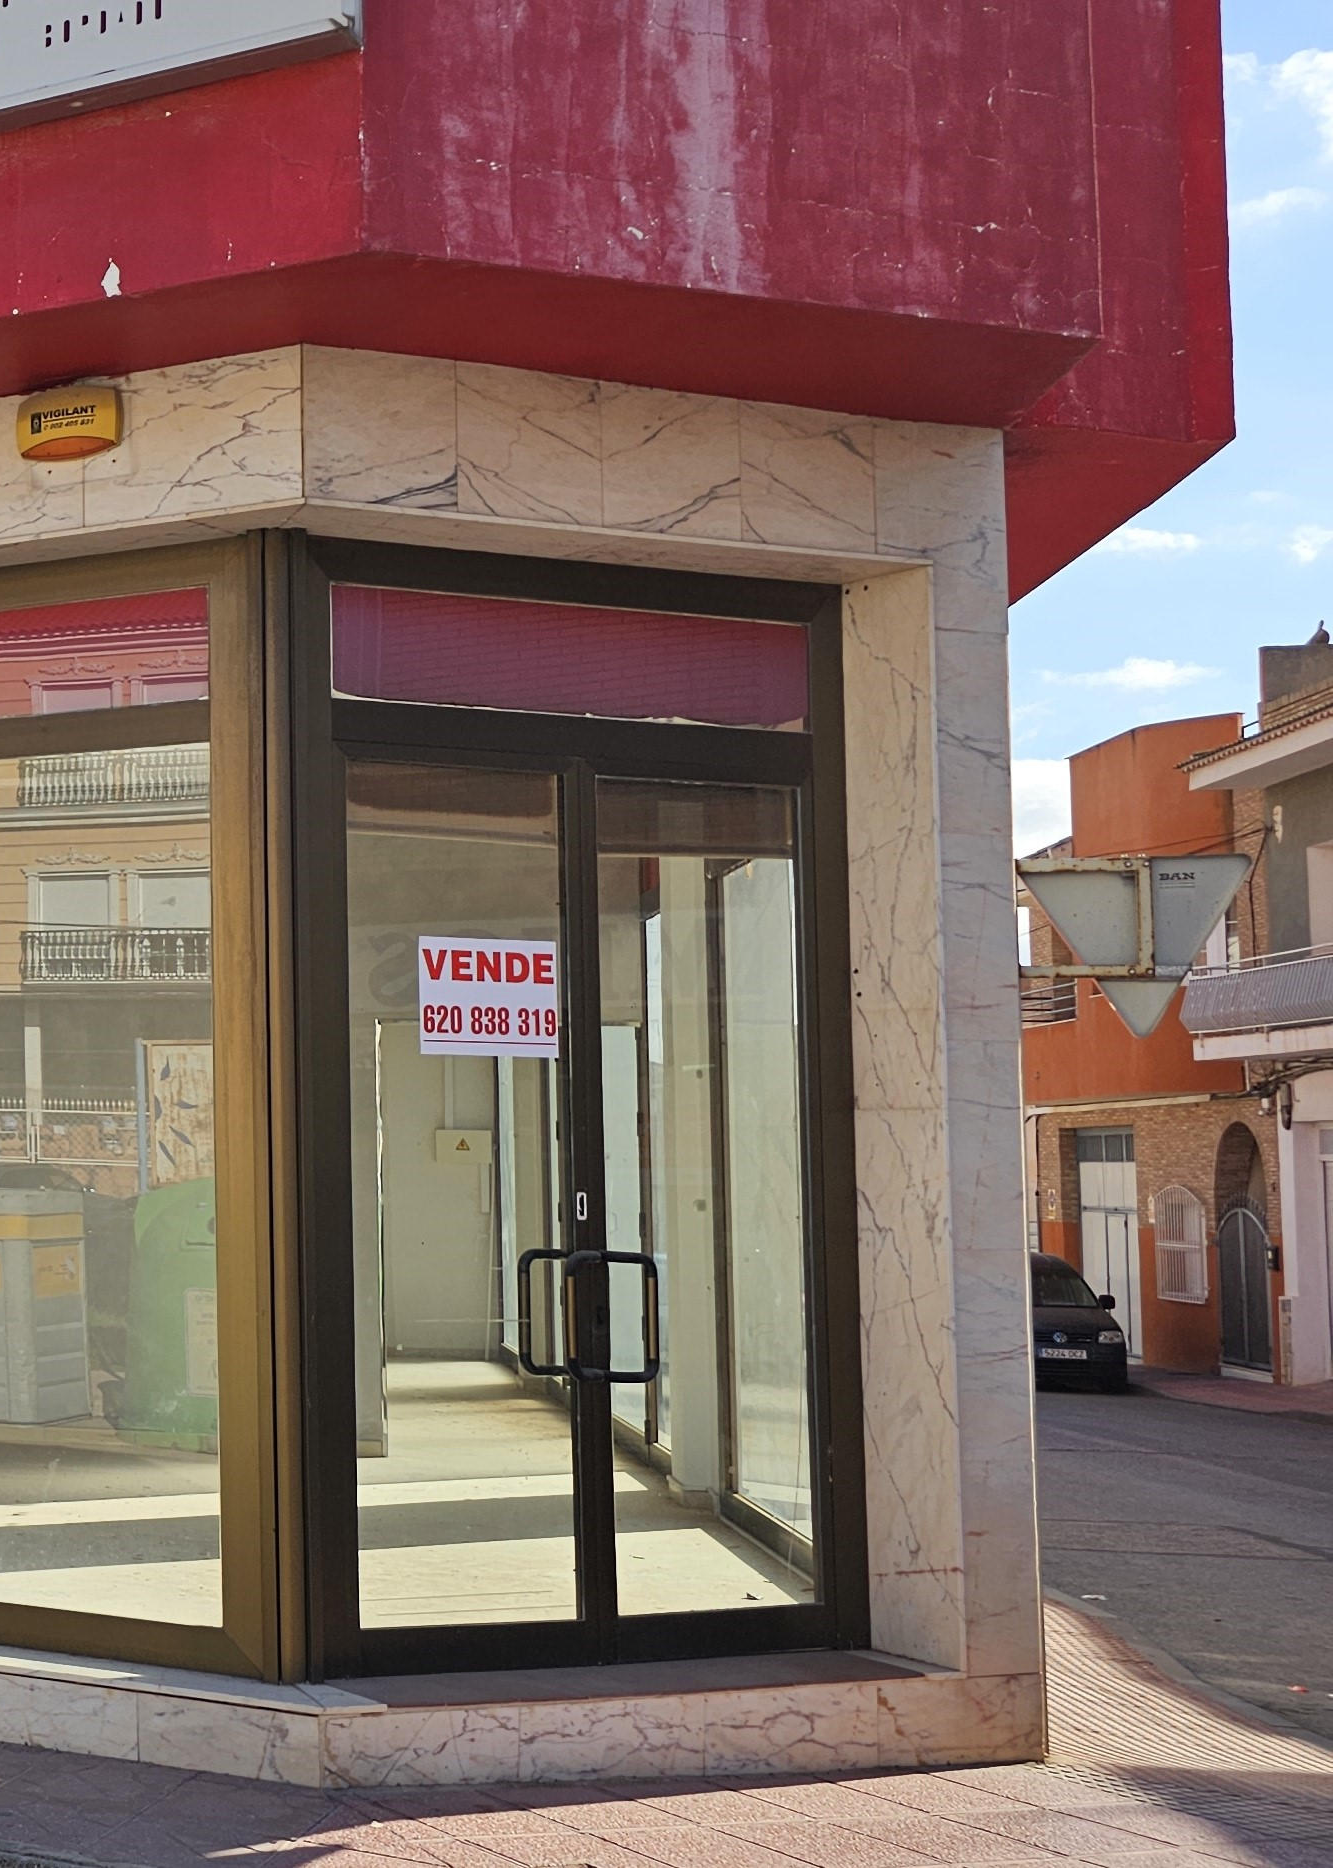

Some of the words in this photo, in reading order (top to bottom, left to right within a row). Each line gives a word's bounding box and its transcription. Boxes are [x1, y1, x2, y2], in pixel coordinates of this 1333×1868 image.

[42, 404, 96, 420] VIGILANT
[422, 948, 554, 984] VENDE
[423, 1004, 462, 1034] 620
[470, 1006, 510, 1036] 838
[517, 1007, 557, 1037] 319
